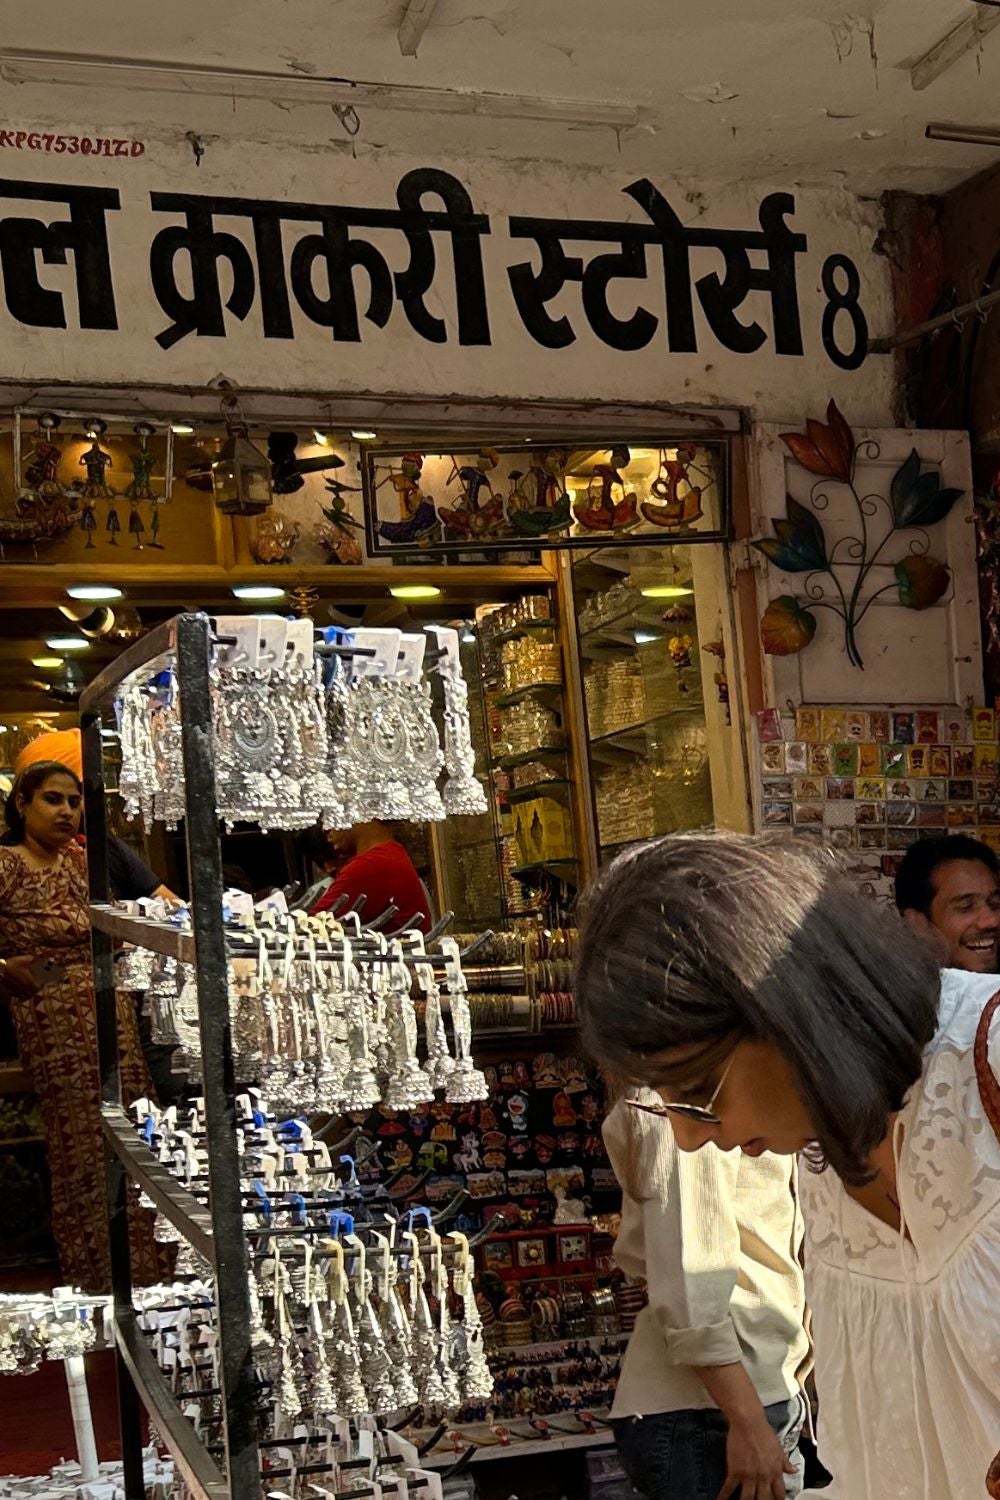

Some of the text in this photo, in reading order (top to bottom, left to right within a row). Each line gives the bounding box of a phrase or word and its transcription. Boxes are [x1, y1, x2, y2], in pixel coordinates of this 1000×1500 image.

[150, 167, 491, 350] क्राकरी
[497, 178, 807, 357] स्टोर्स
[821, 254, 869, 370] 8
